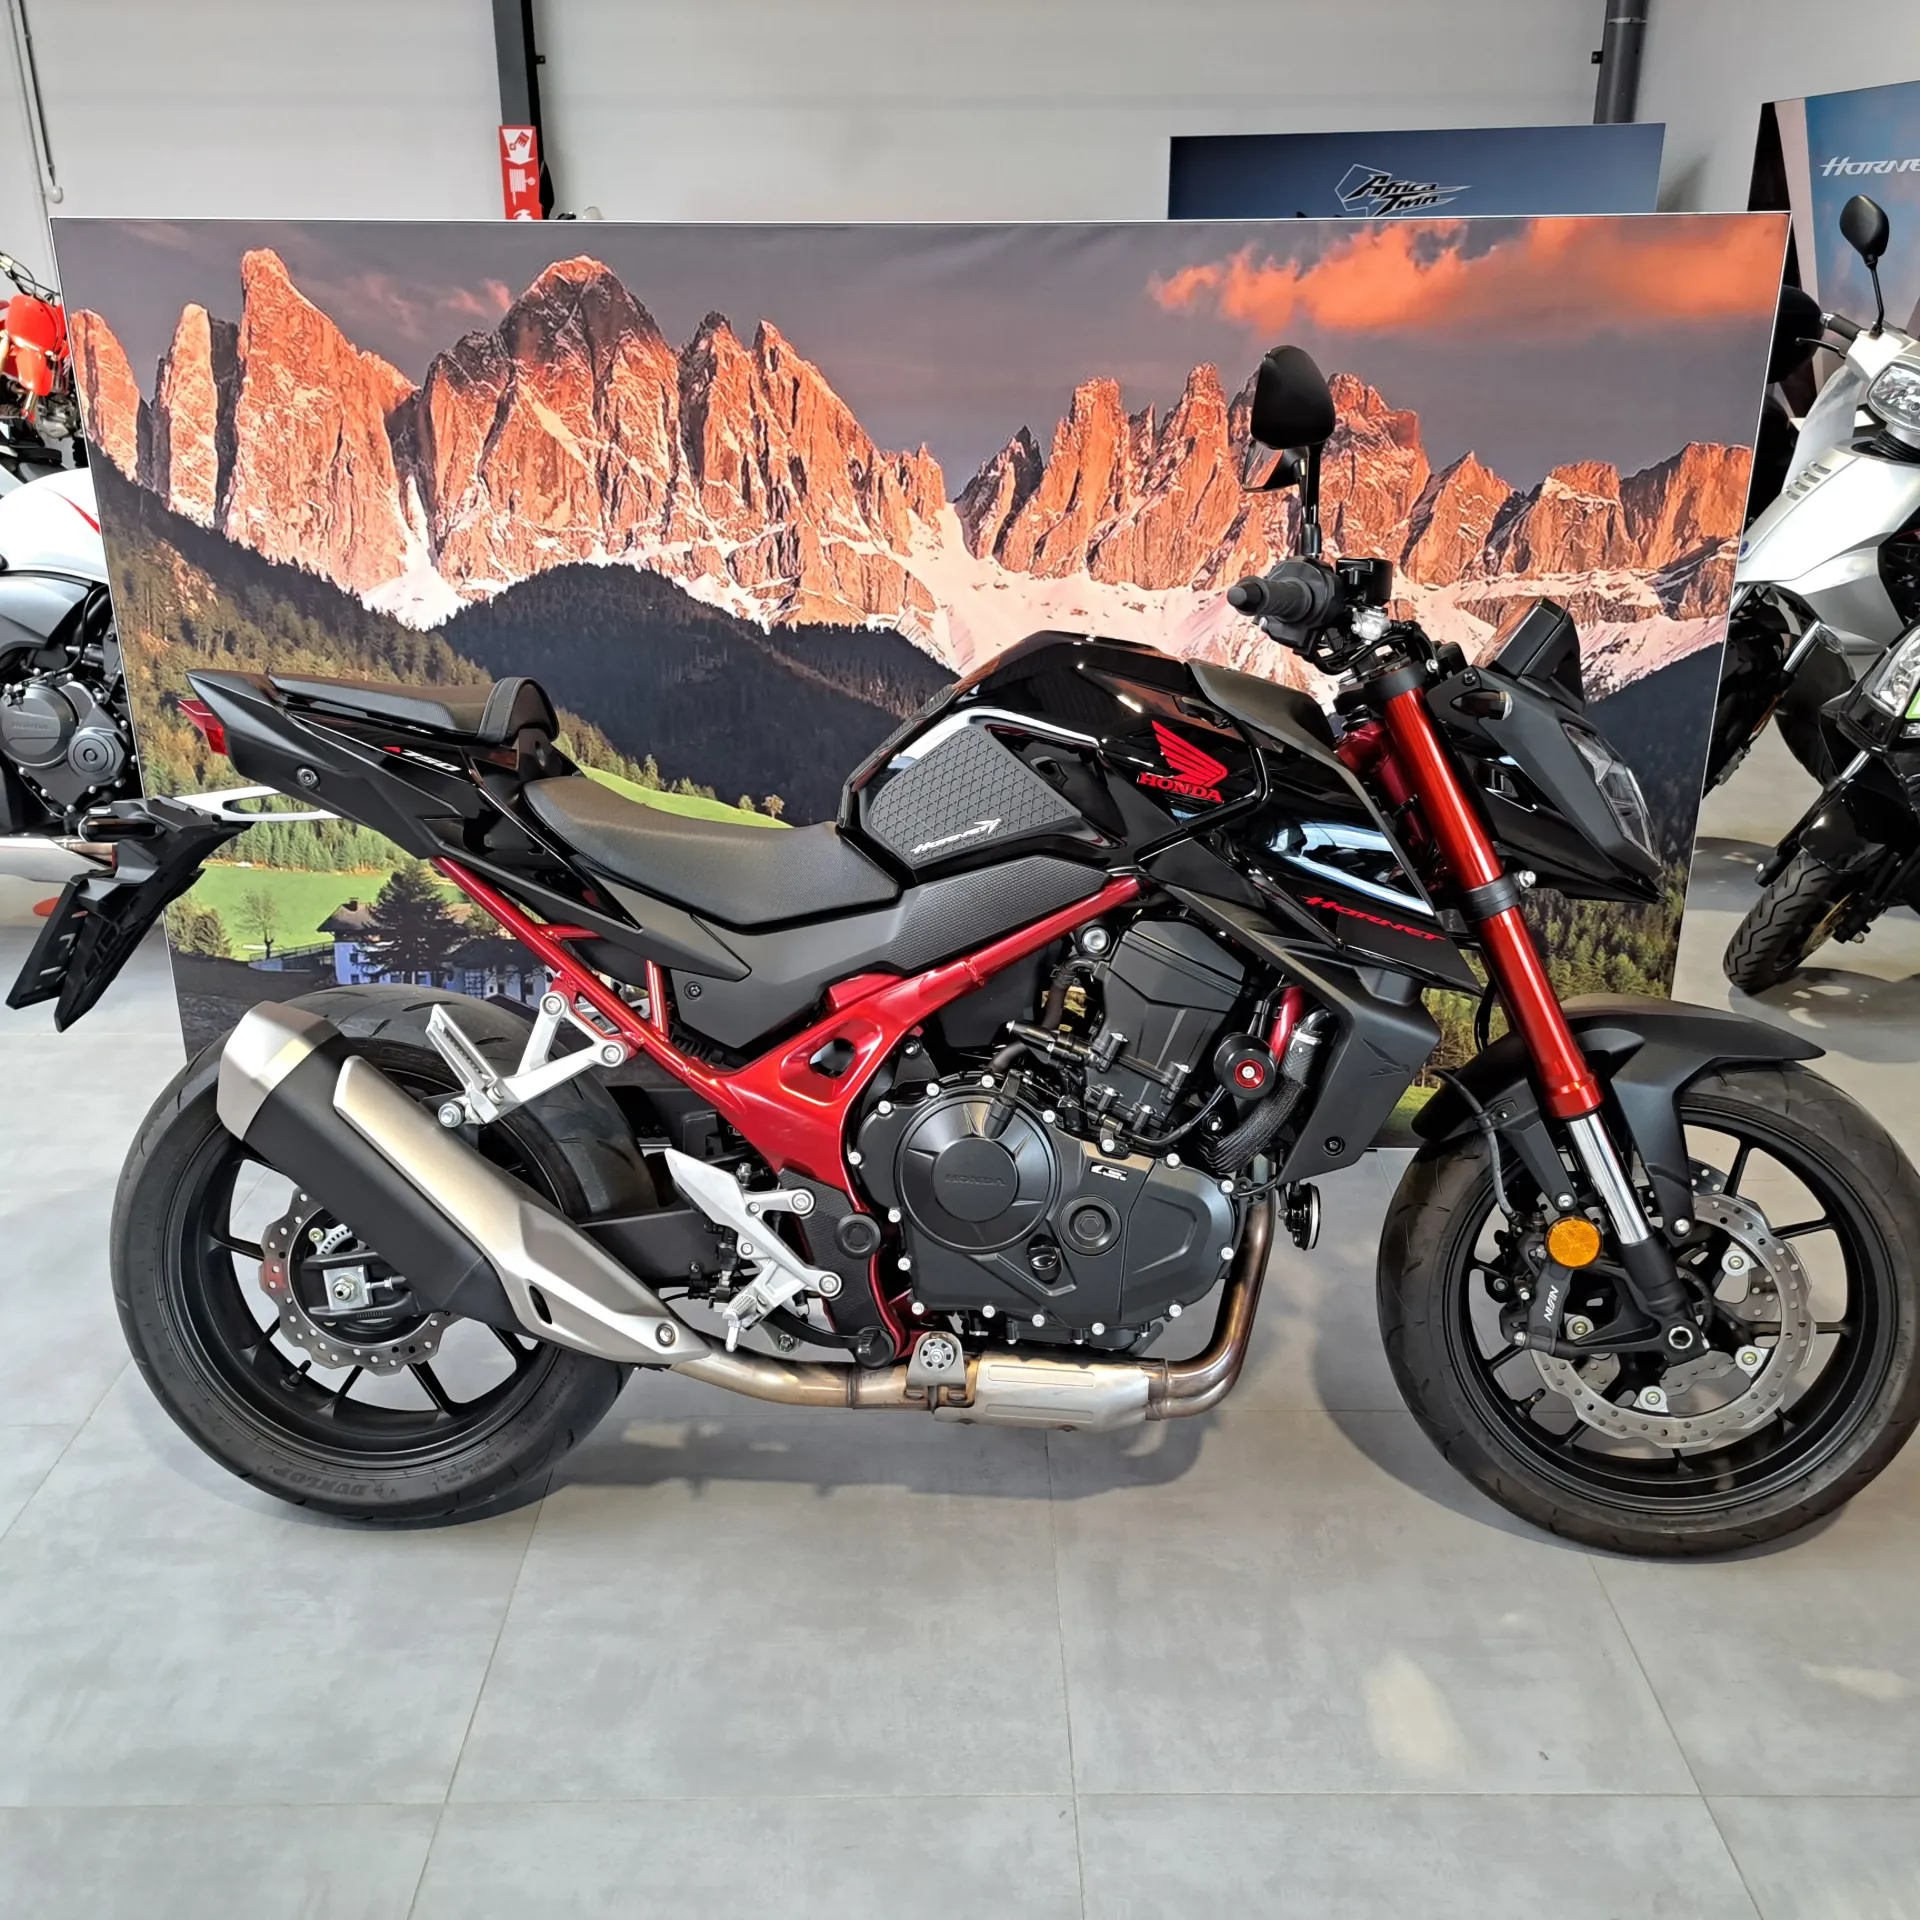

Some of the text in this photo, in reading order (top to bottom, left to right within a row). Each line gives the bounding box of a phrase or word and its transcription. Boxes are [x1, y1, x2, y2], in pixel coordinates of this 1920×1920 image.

[401, 748, 461, 772] 750
[1137, 771, 1225, 804] HONDA
[1299, 895, 1446, 941] HORNET
[945, 1173, 1007, 1187] HONDA
[1543, 1284, 1559, 1322] NISSIN
[271, 1464, 371, 1497] DUNLOP
